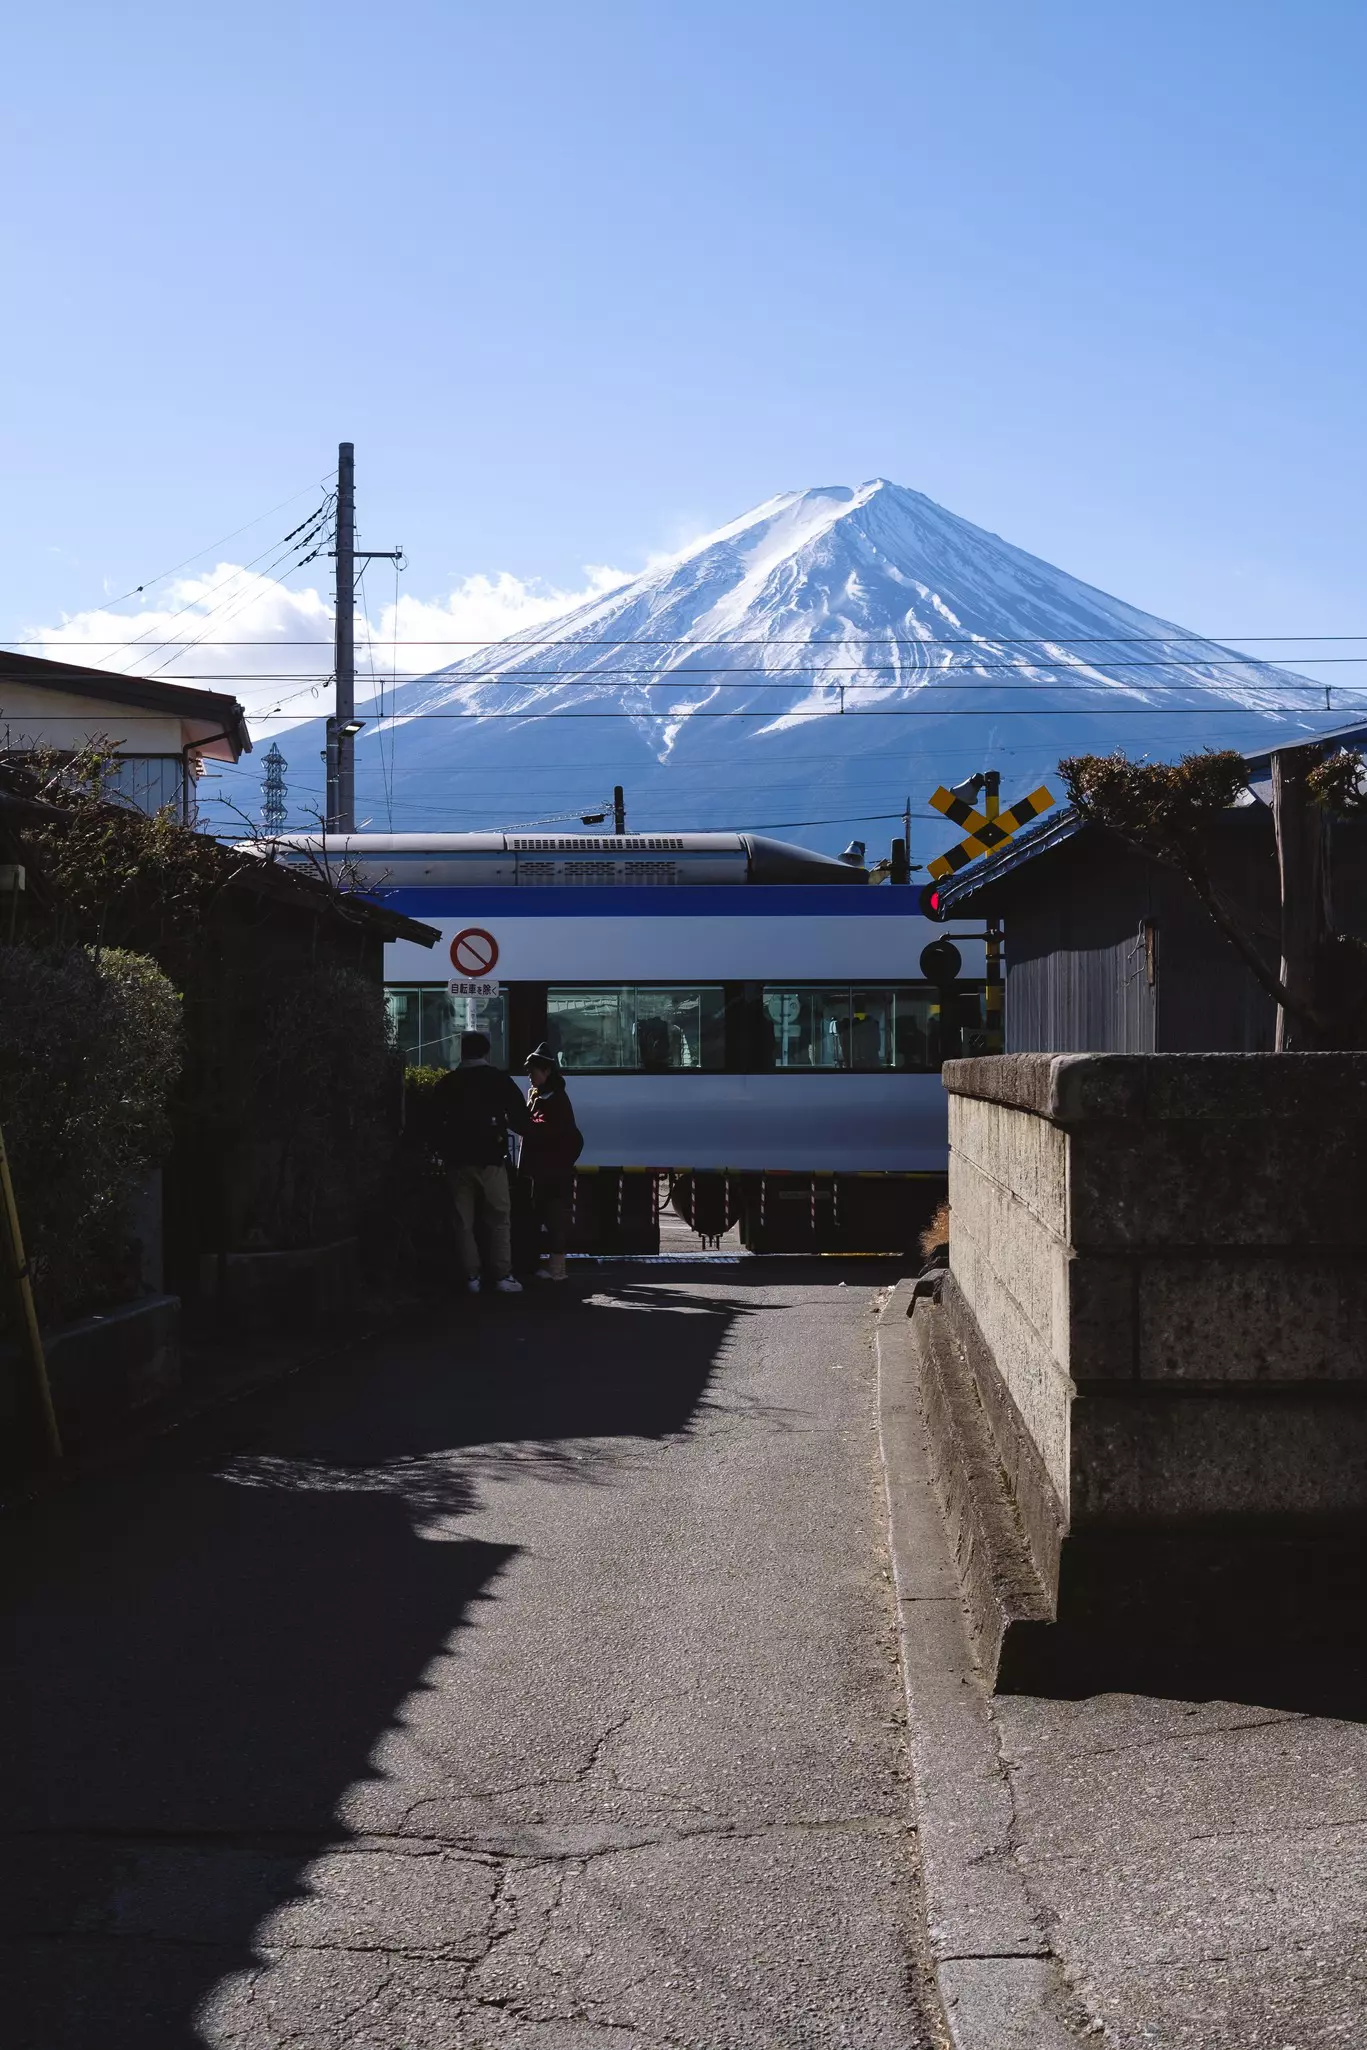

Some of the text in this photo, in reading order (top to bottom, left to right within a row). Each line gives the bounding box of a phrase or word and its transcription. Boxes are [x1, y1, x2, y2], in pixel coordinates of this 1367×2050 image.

[451, 983, 497, 995] 自転車を除く
